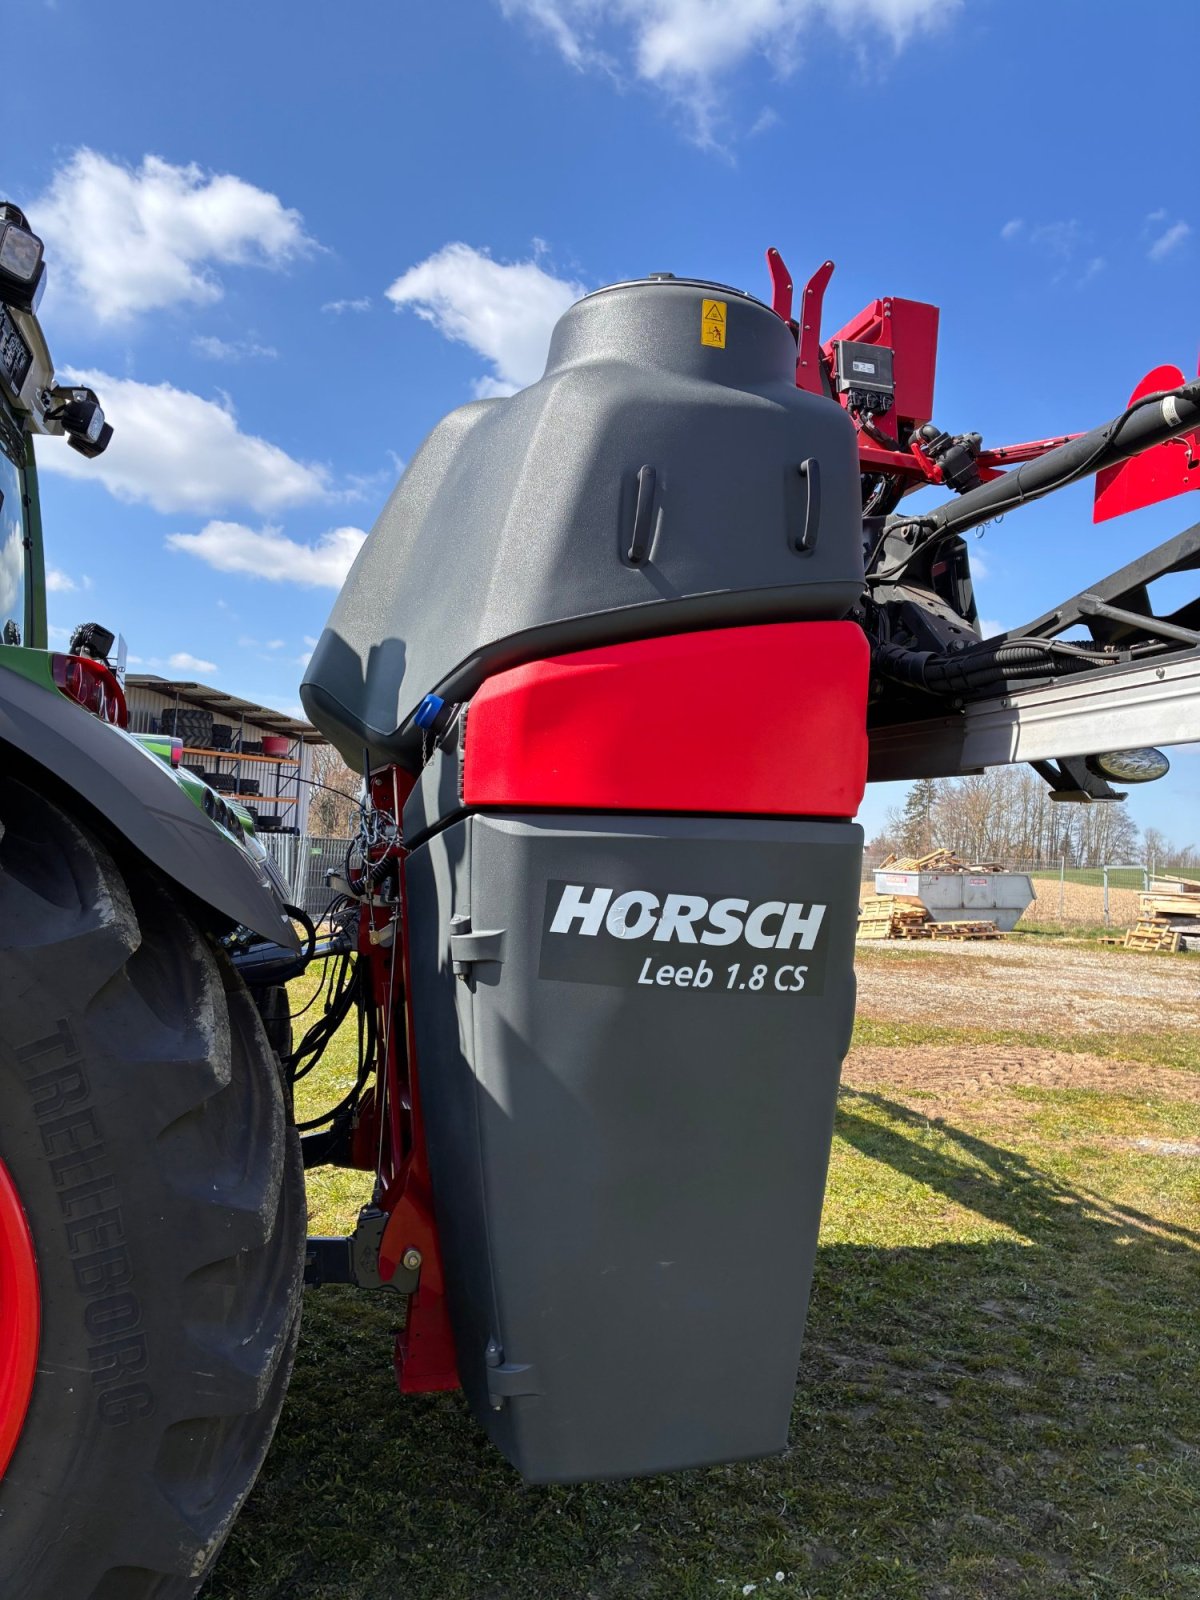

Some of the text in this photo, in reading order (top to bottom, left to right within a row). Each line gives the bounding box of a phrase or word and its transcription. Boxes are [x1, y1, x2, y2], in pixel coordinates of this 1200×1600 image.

[549, 885, 826, 950] HORSCH
[637, 958, 809, 991] Leeb 1.8 CS
[14, 1016, 156, 1427] TRELLEBORG
